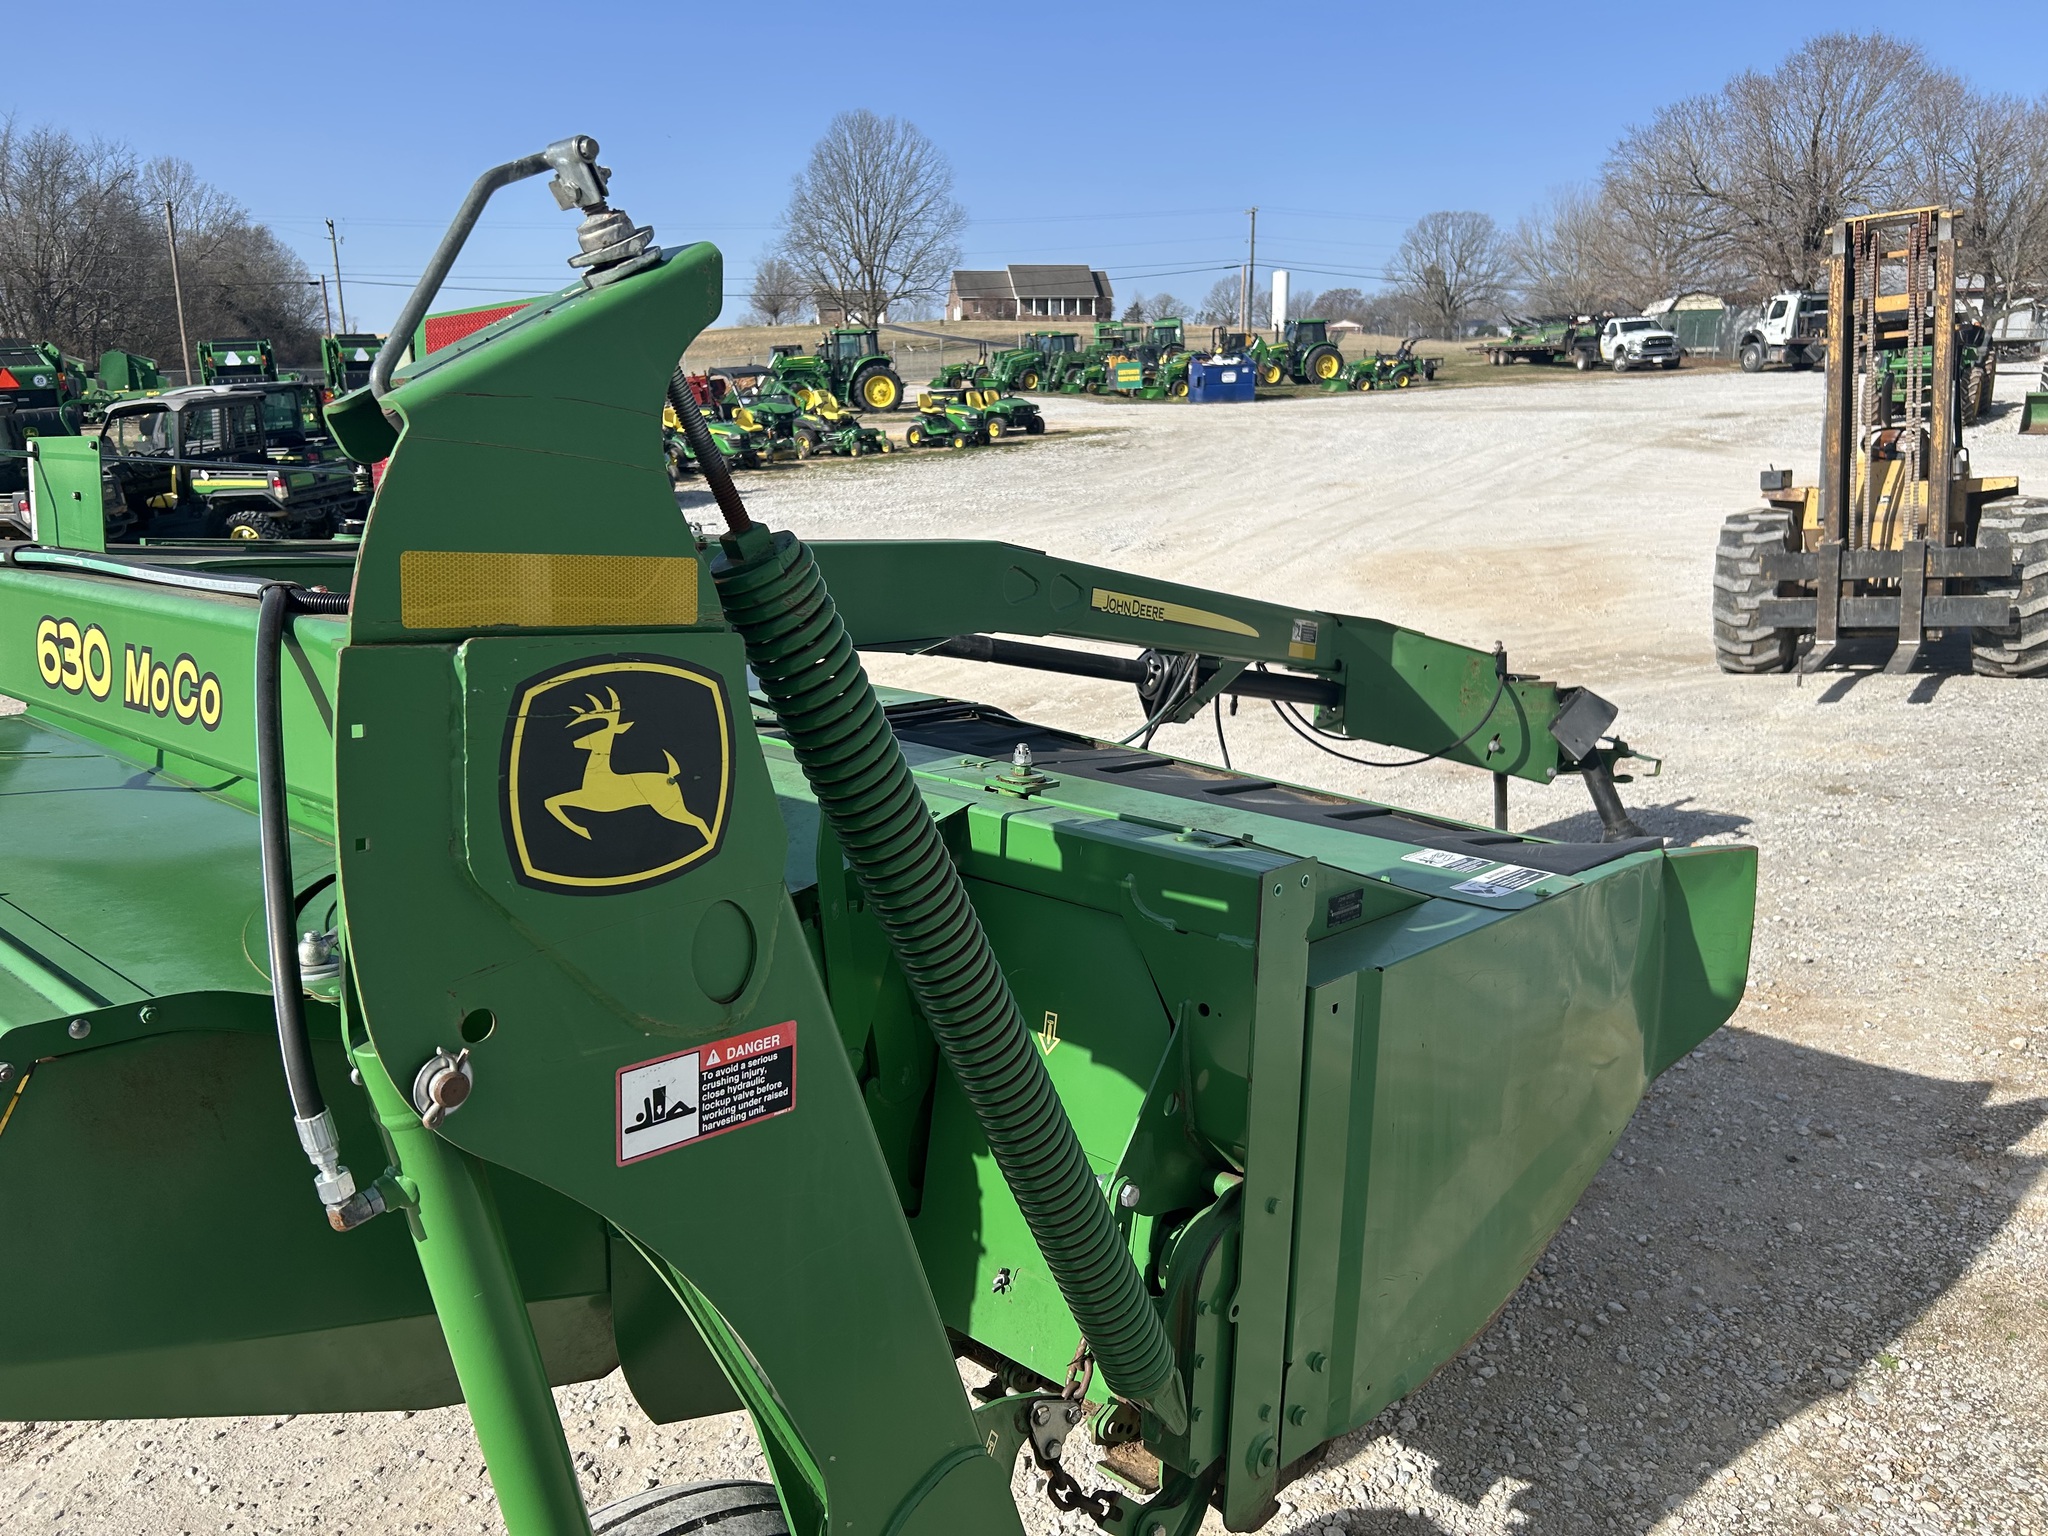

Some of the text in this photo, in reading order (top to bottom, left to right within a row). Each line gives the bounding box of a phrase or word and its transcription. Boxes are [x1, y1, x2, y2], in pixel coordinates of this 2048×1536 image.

[1102, 594, 1165, 620] JOHN DEERE
[37, 616, 222, 729] 630 MoCo
[726, 1034, 780, 1060] DANGER
[702, 1053, 778, 1081] To avoid a serious
[702, 1066, 767, 1092] crushing injury,
[702, 1076, 765, 1101] close hydraulic
[702, 1080, 782, 1112] lockup valve before
[702, 1087, 789, 1121] working under raised
[702, 1110, 747, 1132] harvesting
[748, 1105, 767, 1117] unit.
